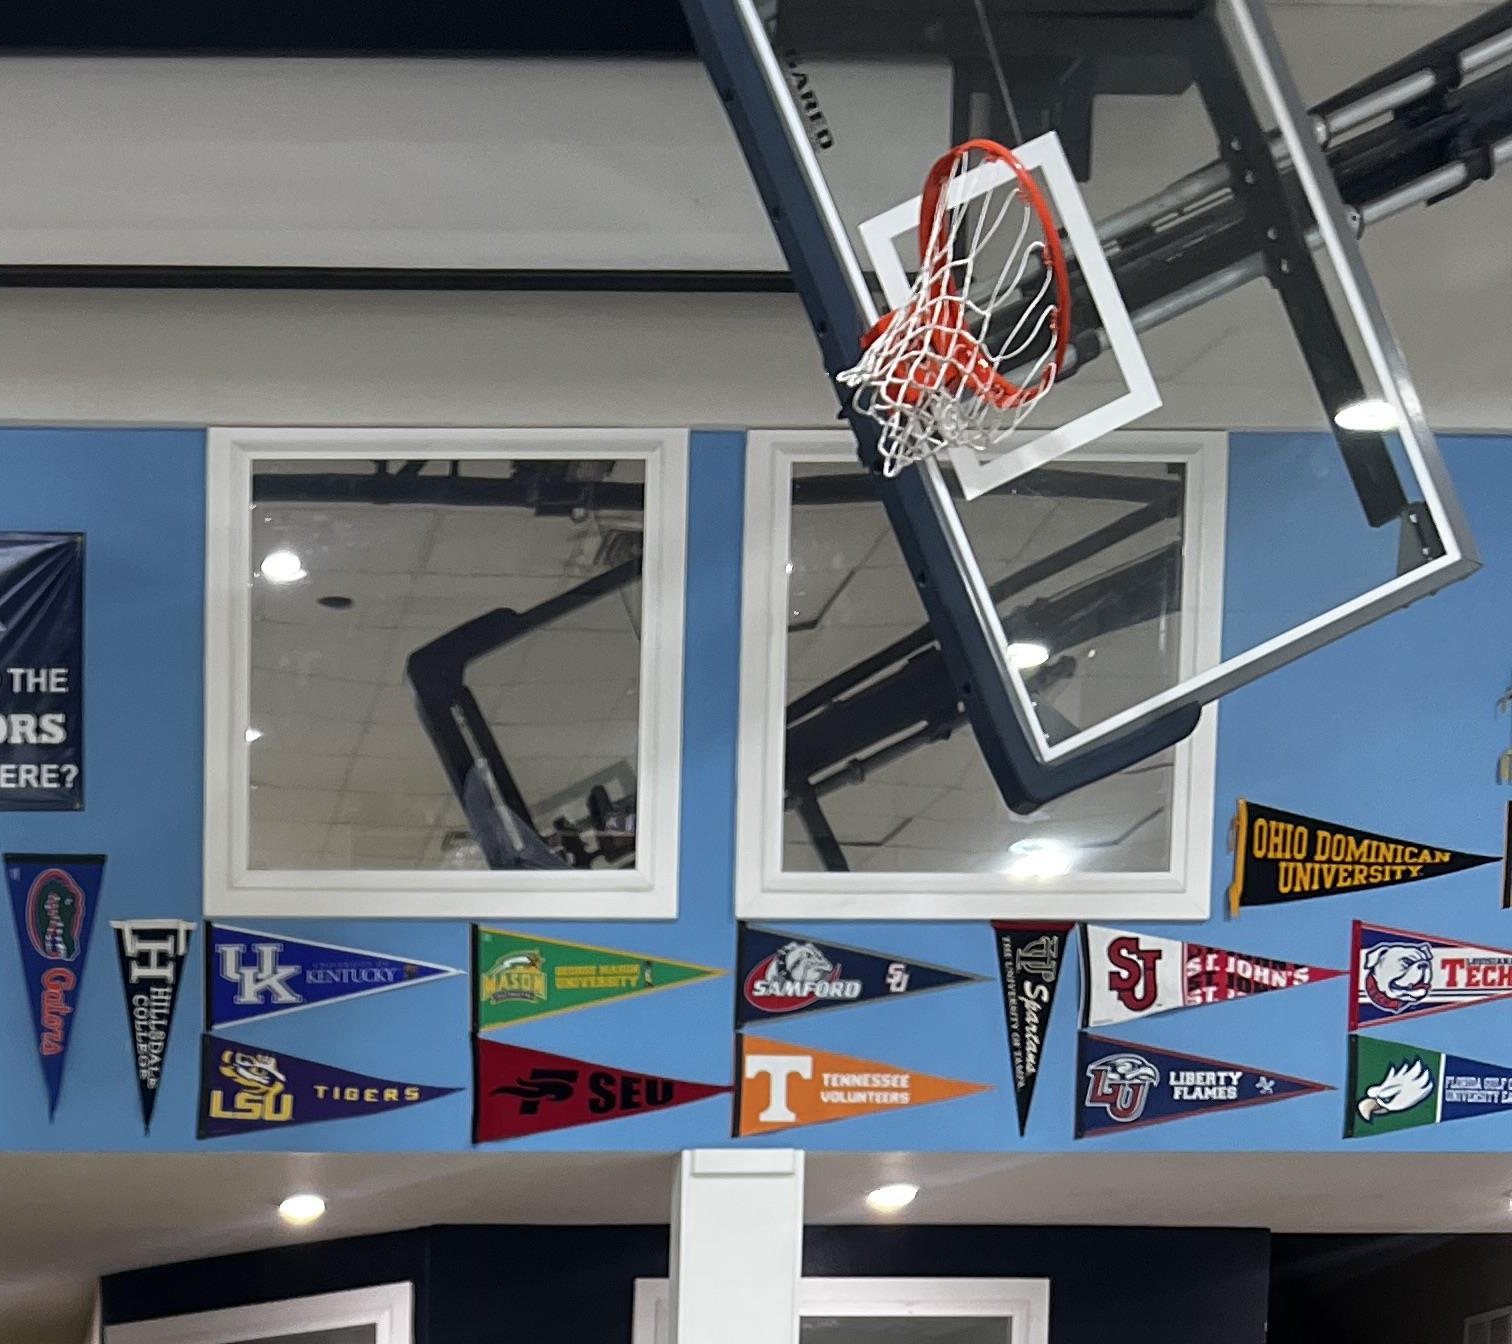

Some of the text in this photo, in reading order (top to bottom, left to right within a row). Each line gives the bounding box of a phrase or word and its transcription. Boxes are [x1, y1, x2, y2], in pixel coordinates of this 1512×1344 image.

[7, 667, 69, 693] THE
[1253, 817, 1452, 865] OHIO DOMINICAN
[1278, 864, 1424, 894] UNIVERSITY
[305, 968, 398, 984] KENTUCKY
[481, 970, 547, 1000] MASON
[1186, 953, 1310, 987] ST. JOHN'S
[752, 979, 862, 998] SAMFORD
[39, 967, 76, 1056] Gators
[132, 994, 149, 1080] COLLEGE
[147, 986, 173, 1090] HILLSDALE
[1018, 980, 1049, 1074] Spartans
[313, 1084, 421, 1102] TIGERS
[588, 1071, 675, 1114] SEU
[821, 1073, 910, 1088] TENNESSEE
[1169, 1071, 1243, 1086] LIBERTY
[1173, 1086, 1238, 1100] FLAMES
[209, 1090, 294, 1121] LSU
[820, 1091, 911, 1105] VOLUNTEERS
